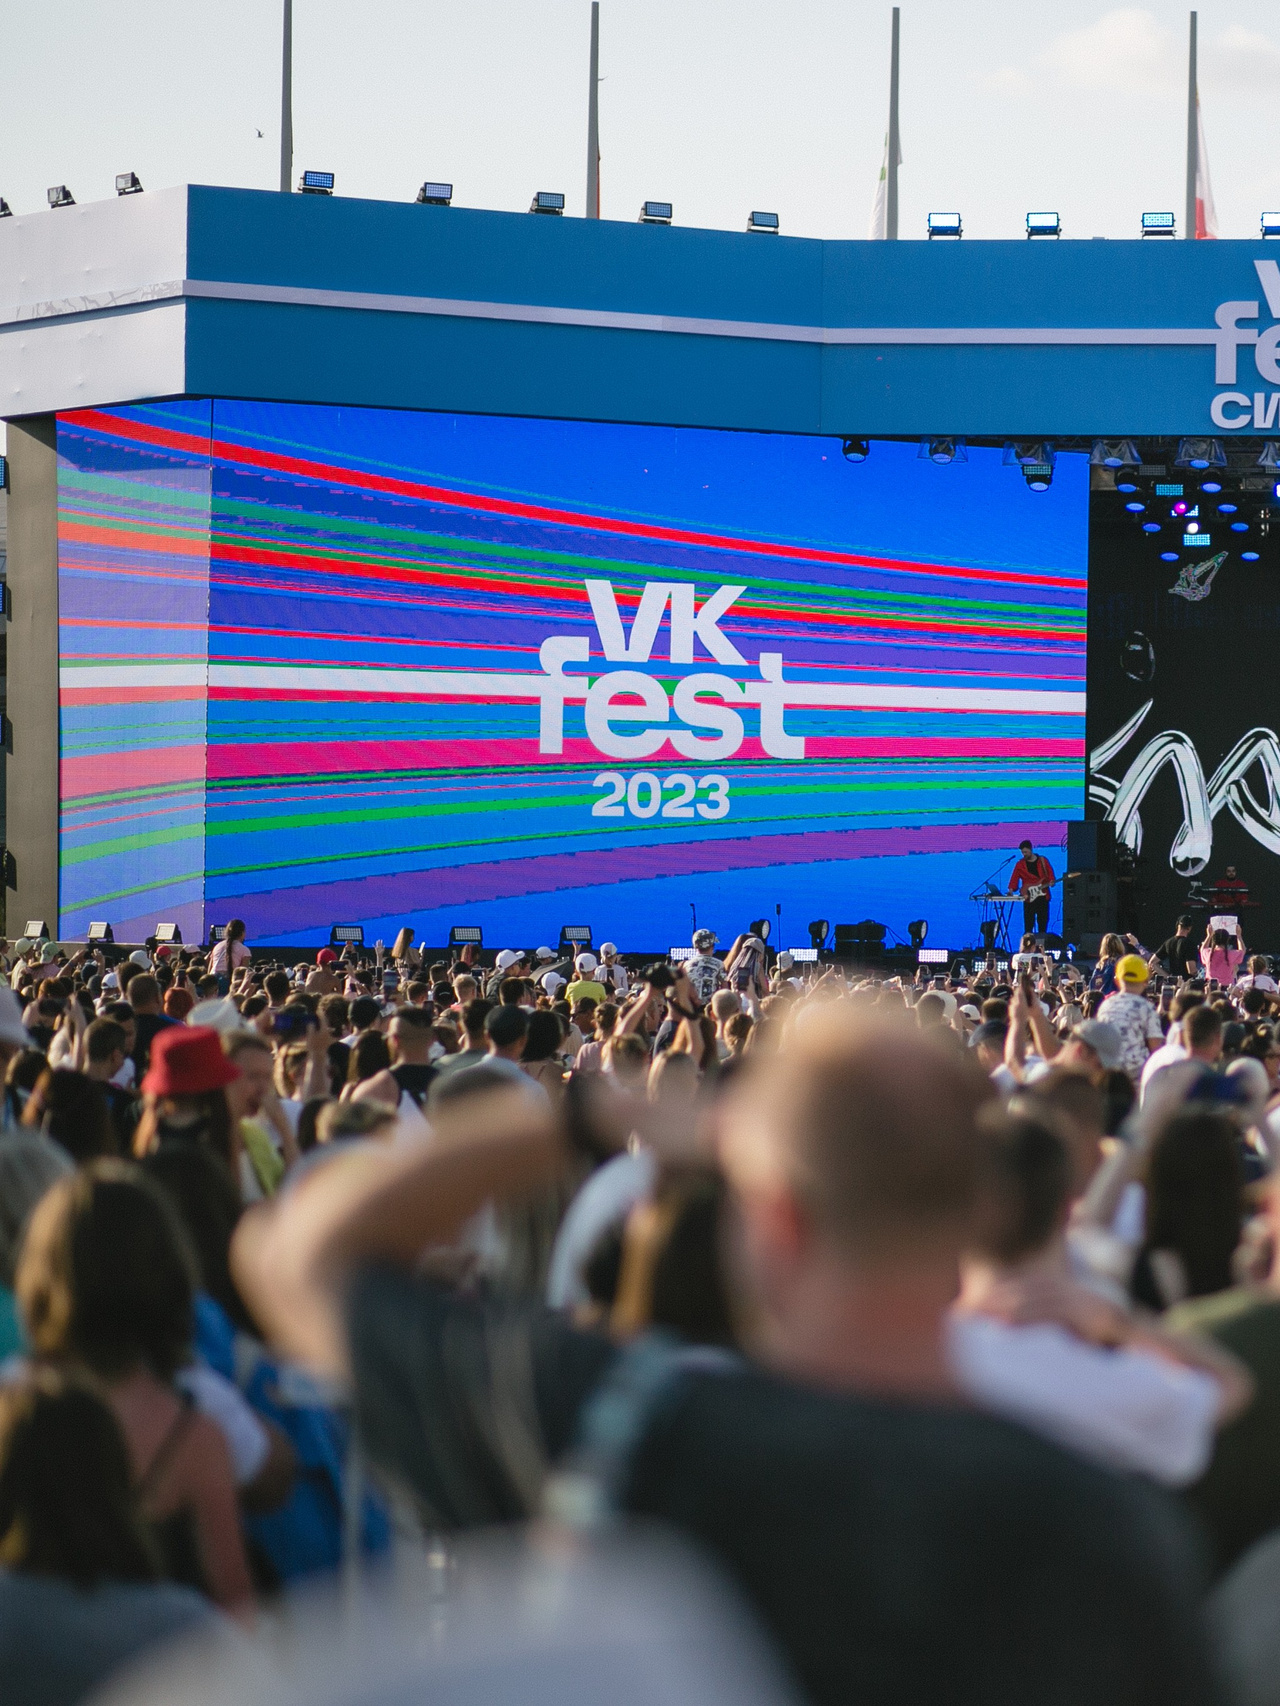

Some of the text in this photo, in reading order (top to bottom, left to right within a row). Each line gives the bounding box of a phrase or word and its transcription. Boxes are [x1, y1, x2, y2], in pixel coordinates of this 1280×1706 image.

[584, 579, 749, 666] VK
[539, 635, 806, 761] fest
[592, 772, 731, 820] 2023
